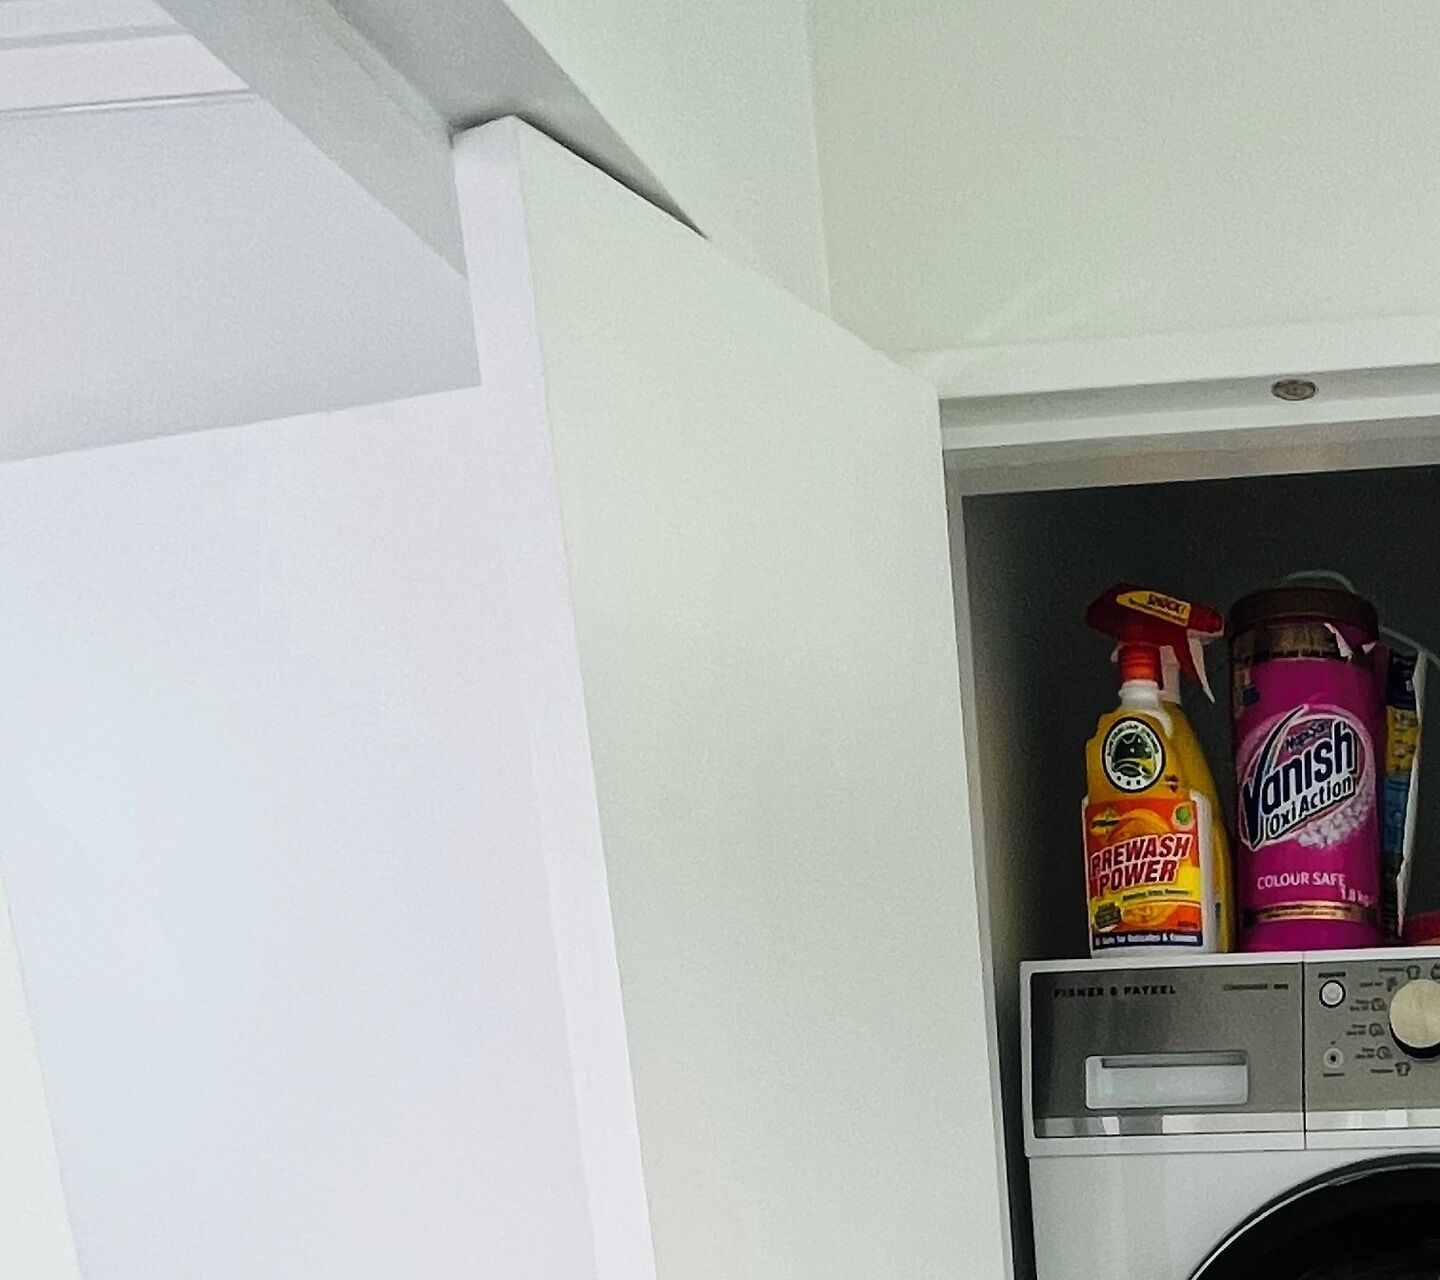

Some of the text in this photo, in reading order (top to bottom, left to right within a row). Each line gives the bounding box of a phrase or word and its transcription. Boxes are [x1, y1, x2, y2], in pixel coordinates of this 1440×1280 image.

[1243, 704, 1354, 848] Vanish
[1269, 774, 1352, 836] Oxi Action
[1091, 834, 1192, 876] PREWASH
[1099, 860, 1178, 898] POWER
[1257, 871, 1345, 890] COLOUR SAFE
[1053, 986, 1104, 998] FISHER
[1123, 984, 1177, 995] PAYKEL
